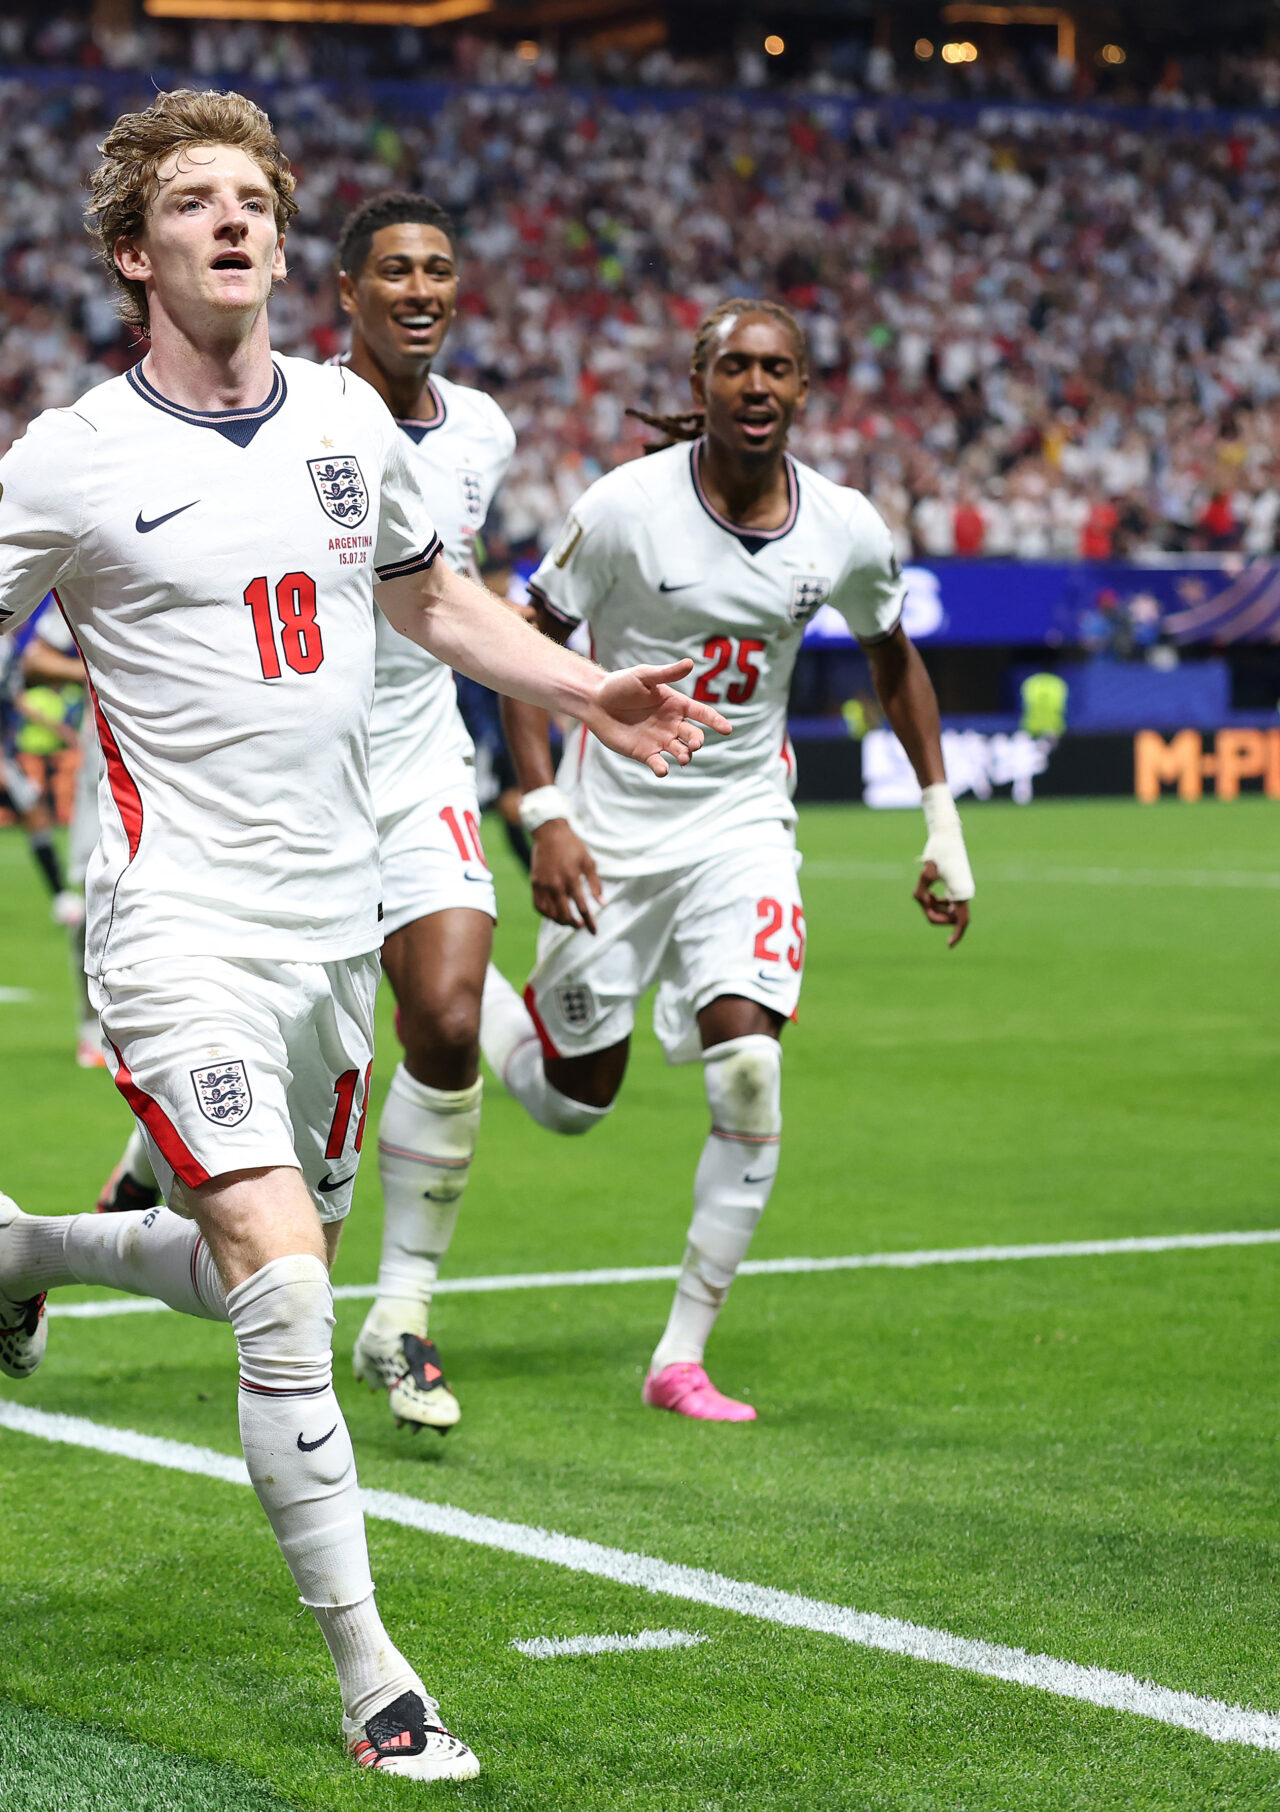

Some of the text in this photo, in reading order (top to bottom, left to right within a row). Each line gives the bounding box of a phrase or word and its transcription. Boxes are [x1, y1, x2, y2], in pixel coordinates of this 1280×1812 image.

[328, 535, 373, 550] ARGENTINA
[339, 551, 367, 565] 15.07.26
[243, 571, 324, 680] 18
[692, 634, 766, 705] 25
[754, 896, 805, 972] 25
